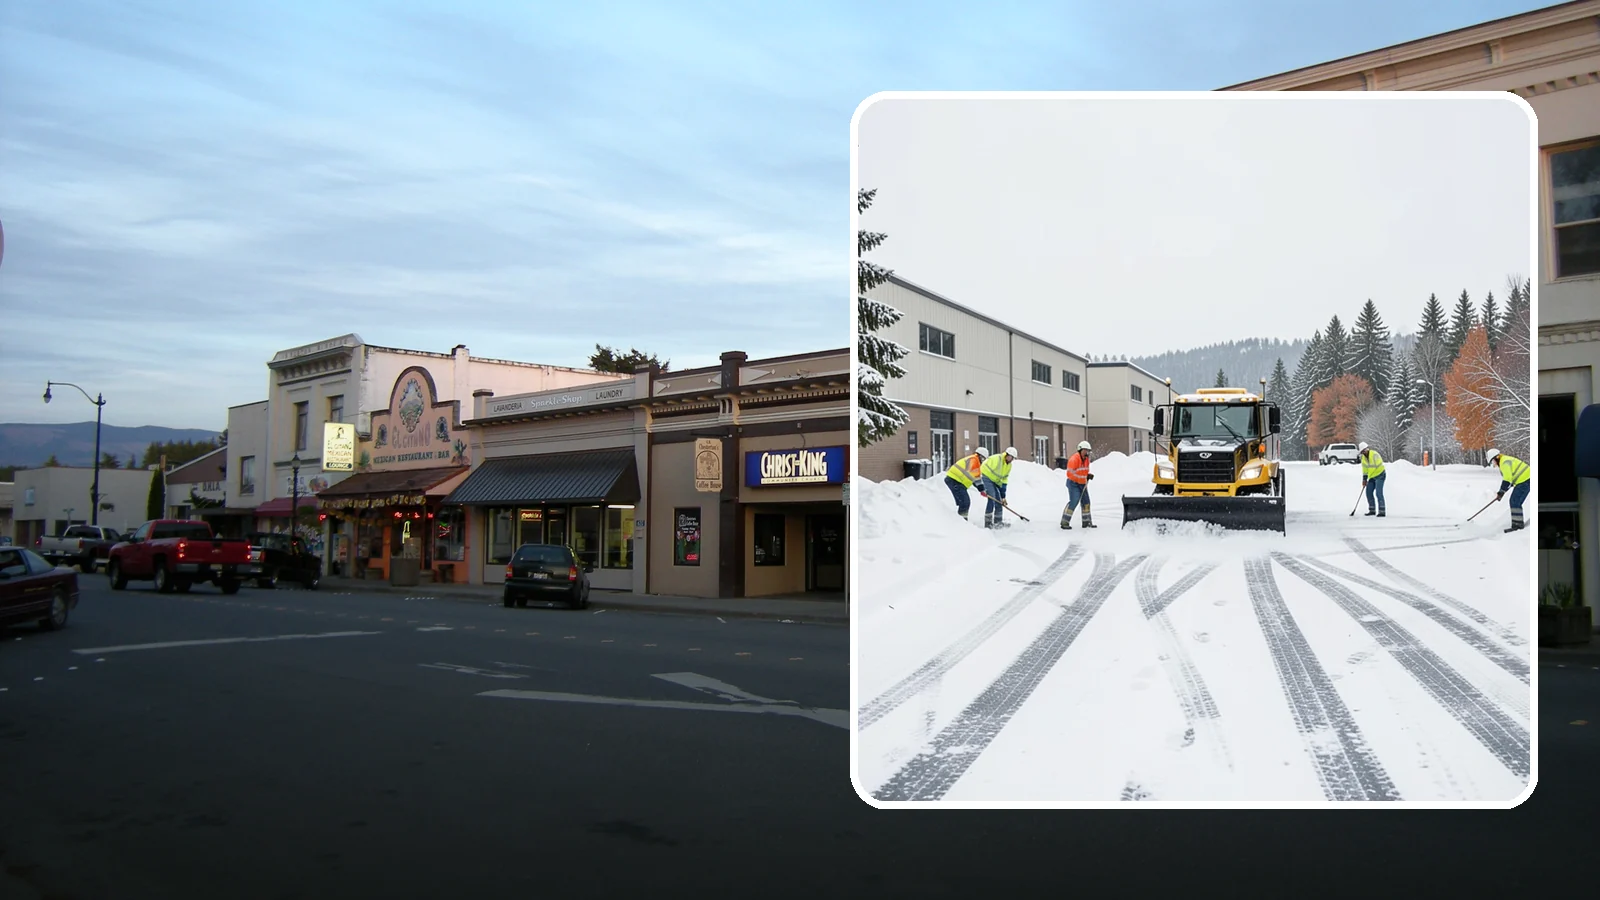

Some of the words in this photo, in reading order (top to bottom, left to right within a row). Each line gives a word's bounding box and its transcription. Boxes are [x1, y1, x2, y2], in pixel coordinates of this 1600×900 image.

[595, 389, 623, 400] LAUNDRY
[493, 402, 522, 413] LAVANDERIA
[530, 398, 560, 409] Sparkle
[561, 394, 582, 404] Shop
[373, 455, 396, 464] MEXICAN
[397, 451, 433, 462] RESTAURANT
[438, 450, 450, 459] BAR
[761, 452, 797, 478] CHRIST
[799, 450, 827, 476] KING
[710, 480, 722, 488] House
